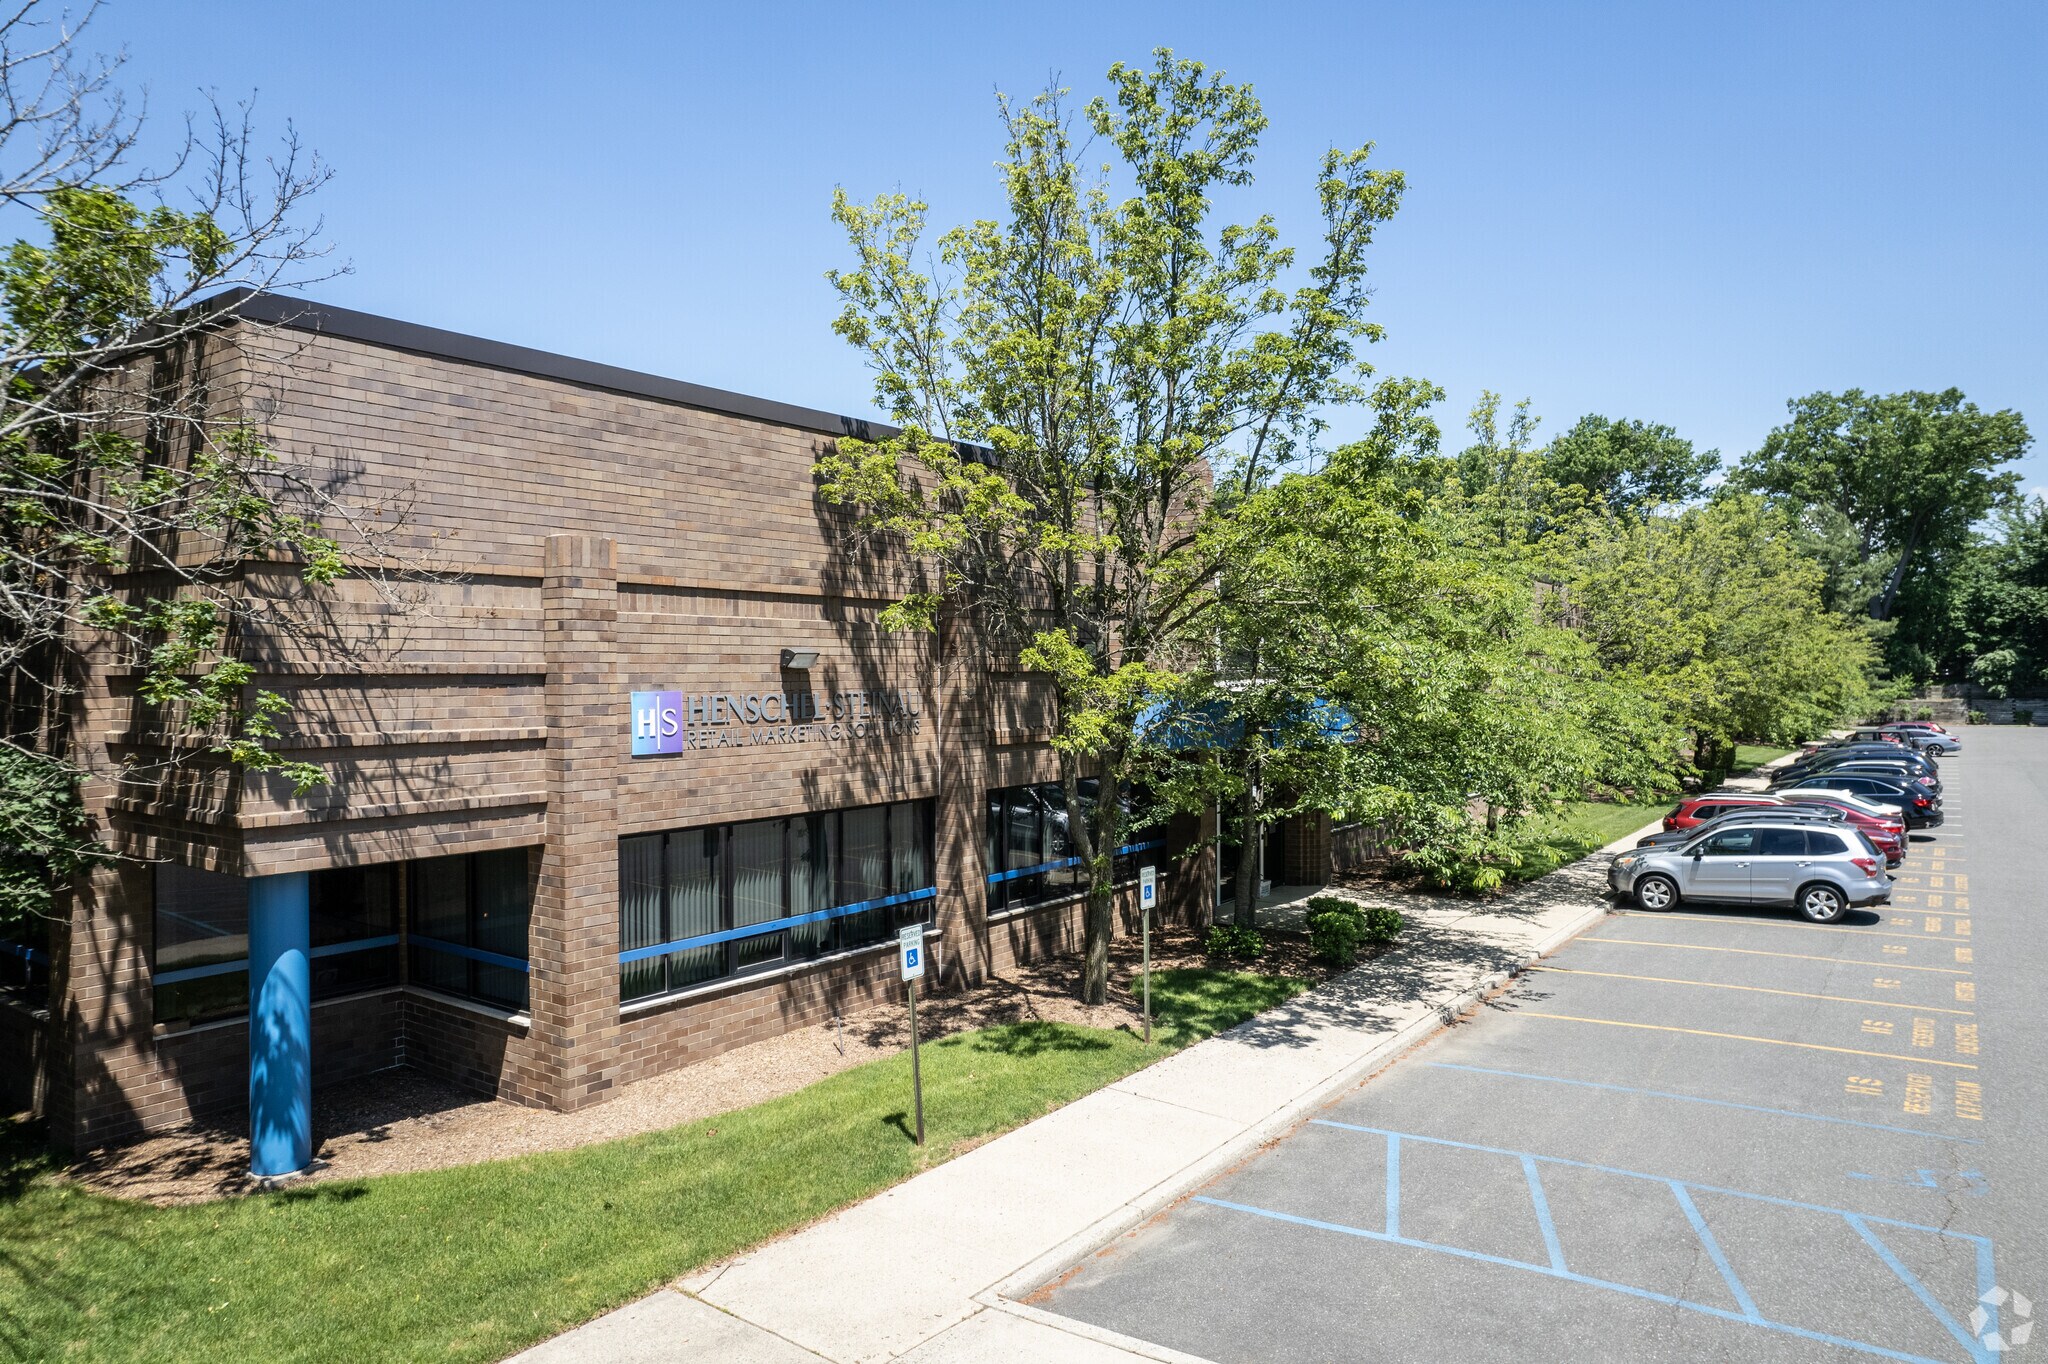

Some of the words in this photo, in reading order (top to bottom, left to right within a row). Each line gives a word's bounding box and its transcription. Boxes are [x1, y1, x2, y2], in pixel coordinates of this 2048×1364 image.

[687, 728, 743, 750] RETAIL
[750, 724, 841, 746] MARKETING
[846, 719, 920, 739] SOLUTIONS
[902, 930, 921, 940] RESERVED
[903, 939, 920, 949] PARKING
